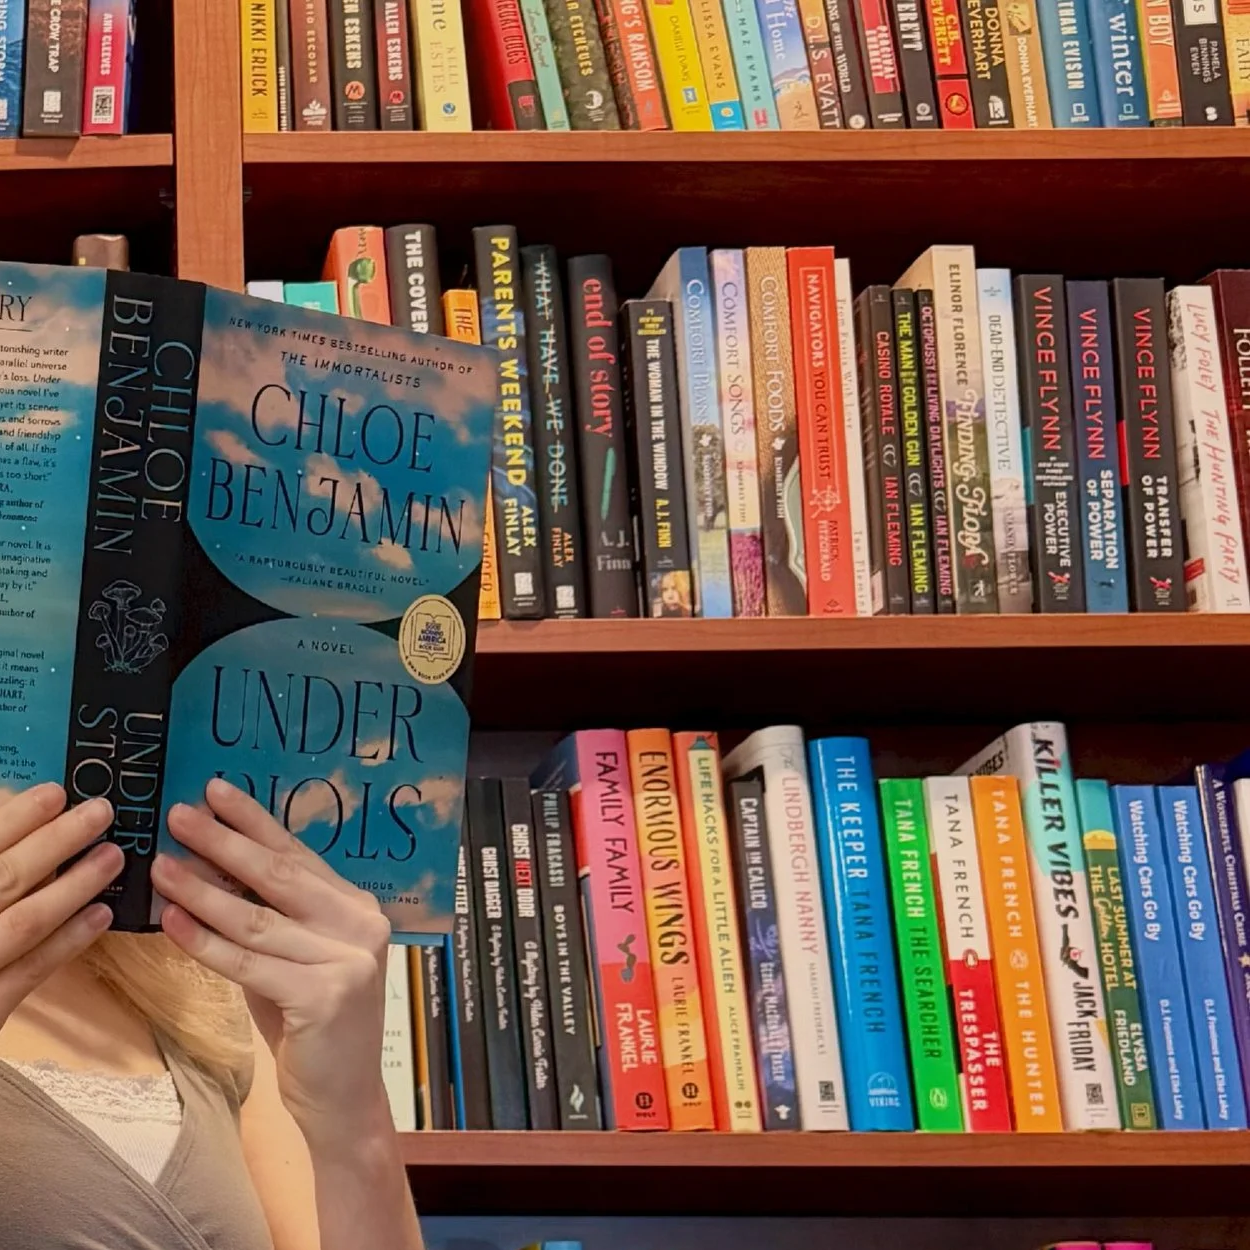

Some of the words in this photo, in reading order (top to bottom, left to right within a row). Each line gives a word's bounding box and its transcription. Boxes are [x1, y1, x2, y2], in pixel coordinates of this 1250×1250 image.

[251, 2, 268, 35] NIKKI
[967, 2, 991, 81] EVERHART
[985, 7, 1004, 66] DONNA
[252, 41, 268, 96] ERLICK
[490, 236, 518, 350] PARENTS
[581, 278, 612, 328] end
[230, 318, 251, 328] NEW
[258, 323, 285, 337] YORK
[292, 331, 325, 346] TIMES
[331, 339, 406, 362] BESTSELLING
[411, 356, 453, 371] AUTHOR
[281, 351, 306, 366] THE
[315, 356, 421, 388] IMMORTALISTS
[586, 339, 615, 363] of
[876, 332, 892, 380] CASINO
[94, 295, 151, 555] BENJAMIN
[141, 342, 194, 522] CHLOE
[251, 384, 435, 473] CHLOE
[500, 358, 527, 486] WEEKEND
[585, 371, 618, 438] story
[879, 383, 895, 435] ROYALE
[206, 459, 465, 555] BENJAMIN
[885, 478, 897, 497] IAN
[1087, 480, 1097, 496] OF
[504, 498, 521, 556] FINLAY
[521, 505, 536, 547] ALEX
[886, 501, 901, 565] FLEMING
[1088, 501, 1103, 560] POWER
[1100, 470, 1119, 569] SEPARATION
[32, 569, 48, 577] and
[250, 556, 325, 574] RAPTUROUSLY
[330, 567, 386, 581] BEAUTIFUL
[338, 582, 384, 594] BRADLEY
[21, 649, 44, 660] novel
[298, 640, 304, 648] A
[312, 640, 354, 654] NOVEL
[211, 665, 425, 763] UNDER
[118, 711, 163, 857] UNDER
[595, 751, 626, 826] FAMILY
[835, 756, 856, 791] THE
[1033, 738, 1065, 832] KILLER
[214, 771, 422, 861] STO
[841, 803, 867, 878] KEEPER
[1129, 800, 1149, 864] Watching
[604, 838, 634, 914] FAMILY
[1048, 843, 1078, 919] VIBES
[1138, 870, 1155, 897] Cars
[1144, 901, 1159, 921] Go
[1144, 923, 1161, 941] By
[615, 1003, 637, 1072] FRANKEL
[637, 1009, 657, 1064] LAURIE
[959, 989, 988, 1111] TRESPASSER
[983, 1031, 1000, 1068] THE
